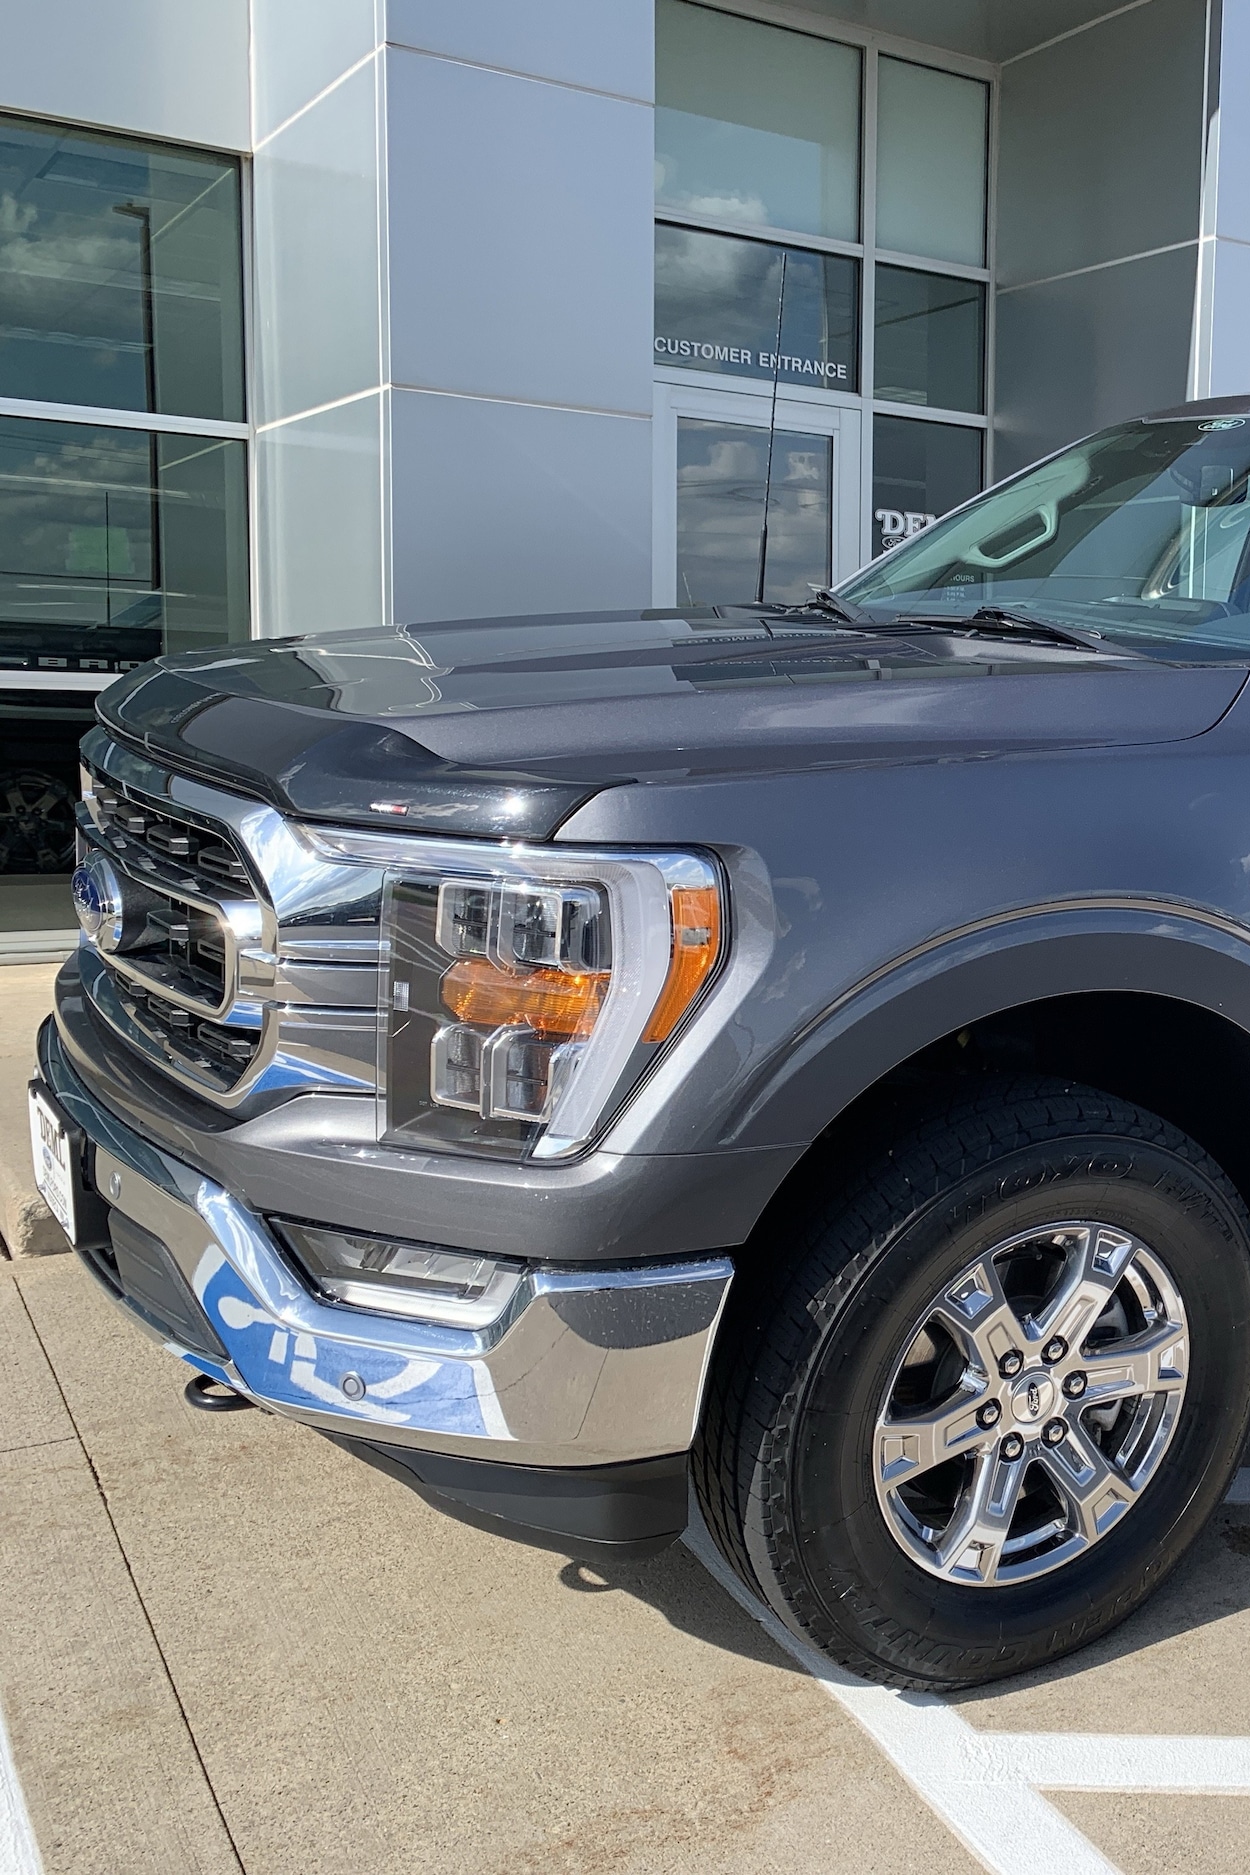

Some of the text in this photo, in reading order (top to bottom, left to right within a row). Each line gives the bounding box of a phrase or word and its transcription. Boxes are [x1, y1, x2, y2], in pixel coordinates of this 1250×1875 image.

[654, 336, 847, 380] CUSTOMER ENTRANCE
[949, 1152, 1136, 1223] TOYO
